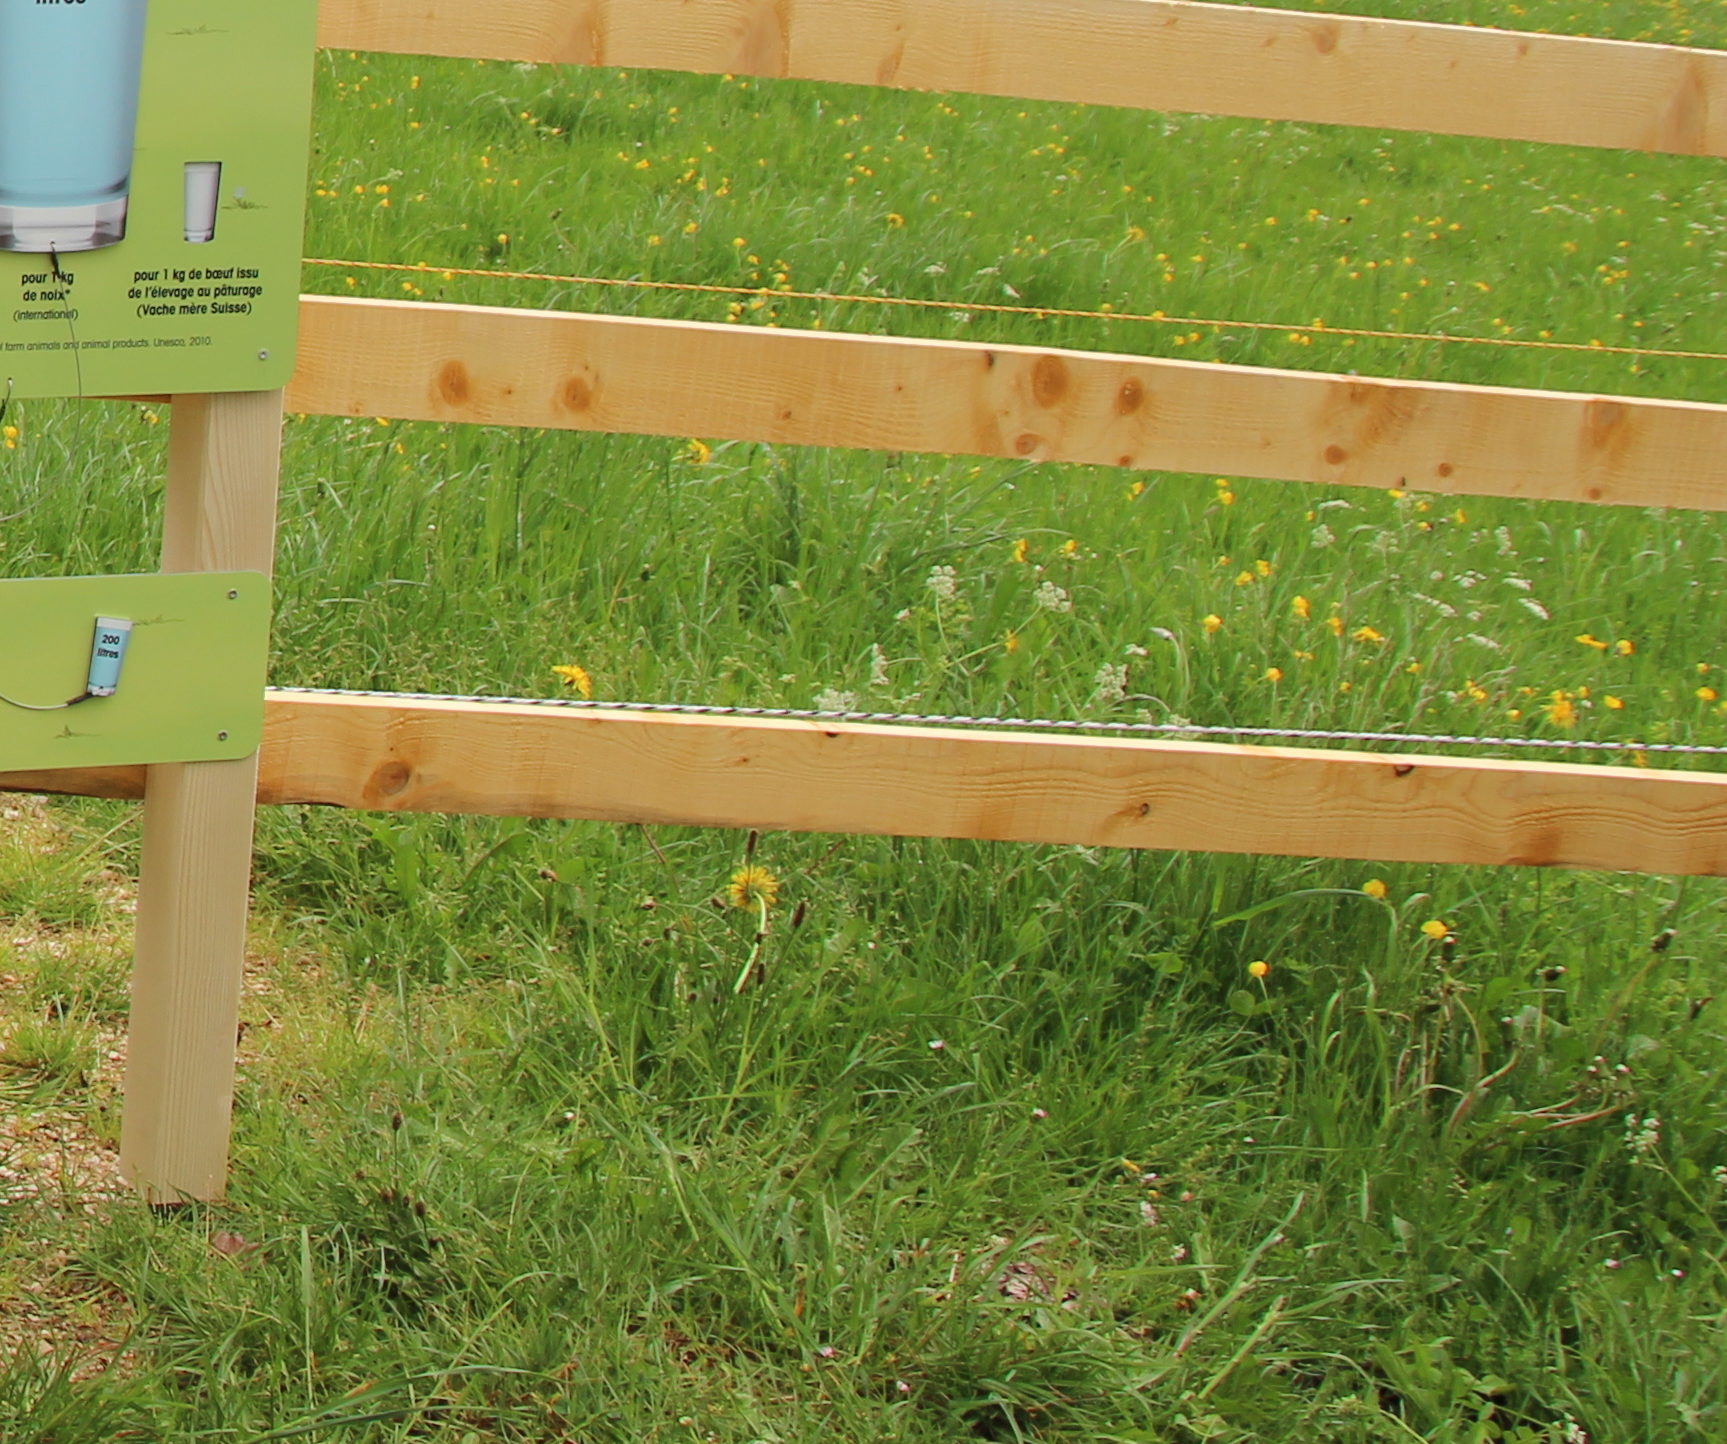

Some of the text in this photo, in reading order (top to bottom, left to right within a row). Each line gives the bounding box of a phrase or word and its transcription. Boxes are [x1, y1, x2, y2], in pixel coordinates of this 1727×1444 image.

[21, 271, 48, 286] pour
[133, 266, 259, 284] pour 1 kg de bœuf issu
[127, 287, 142, 299] de
[196, 287, 211, 298] au
[213, 283, 263, 300] pâturage
[136, 301, 252, 319] (Vache mère Suisse)
[102, 634, 120, 645] 200
